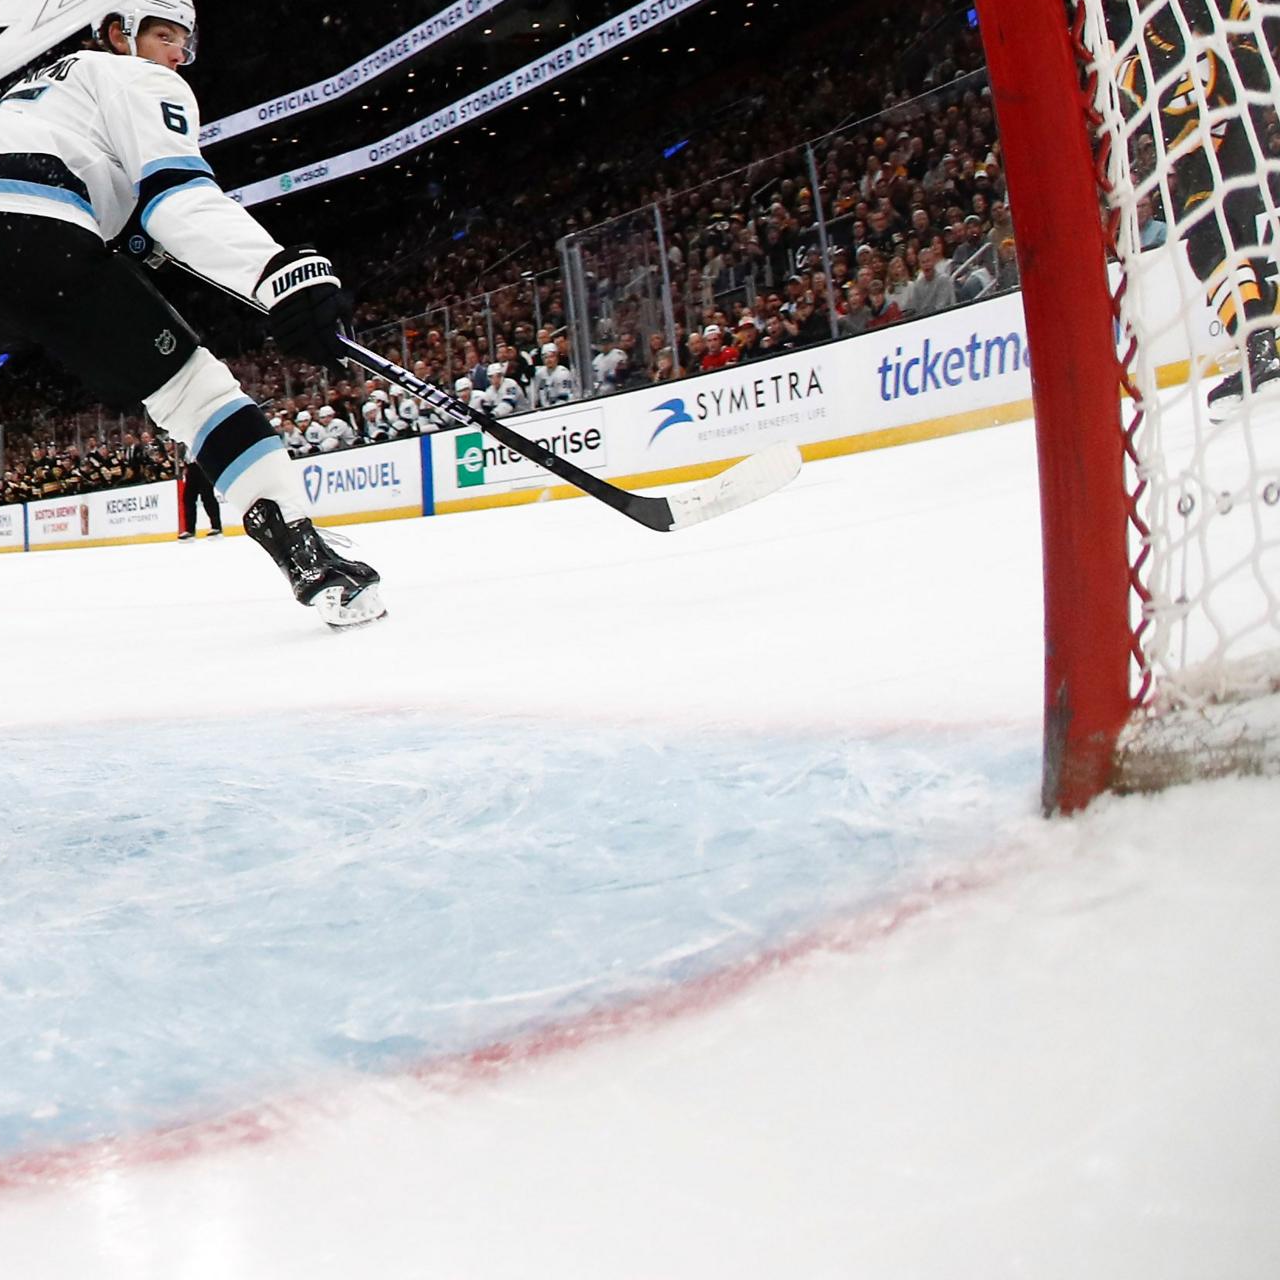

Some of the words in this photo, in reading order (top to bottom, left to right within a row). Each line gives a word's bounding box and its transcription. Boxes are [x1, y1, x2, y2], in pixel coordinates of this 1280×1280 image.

[257, 88, 320, 122] OFFICIAL
[322, 68, 360, 98] CLOUD
[362, 37, 411, 78] STORAGE
[411, 7, 464, 51] PARTNER
[160, 101, 188, 136] 6
[292, 166, 329, 185] wasabi
[368, 129, 419, 163] OFFICIAL
[419, 105, 458, 140] CLOUD
[459, 81, 514, 120] STORAGE
[515, 50, 575, 93] PARTNER
[576, 37, 596, 59] OF
[598, 17, 628, 48] THE
[696, 368, 824, 421] SYMETRA
[698, 422, 751, 441] RETIREMENT
[757, 411, 801, 431] BENEFITS
[807, 407, 827, 421] LIFE
[326, 460, 401, 495] FANDUEL
[106, 498, 139, 514] KECHES
[139, 494, 160, 511] LAW
